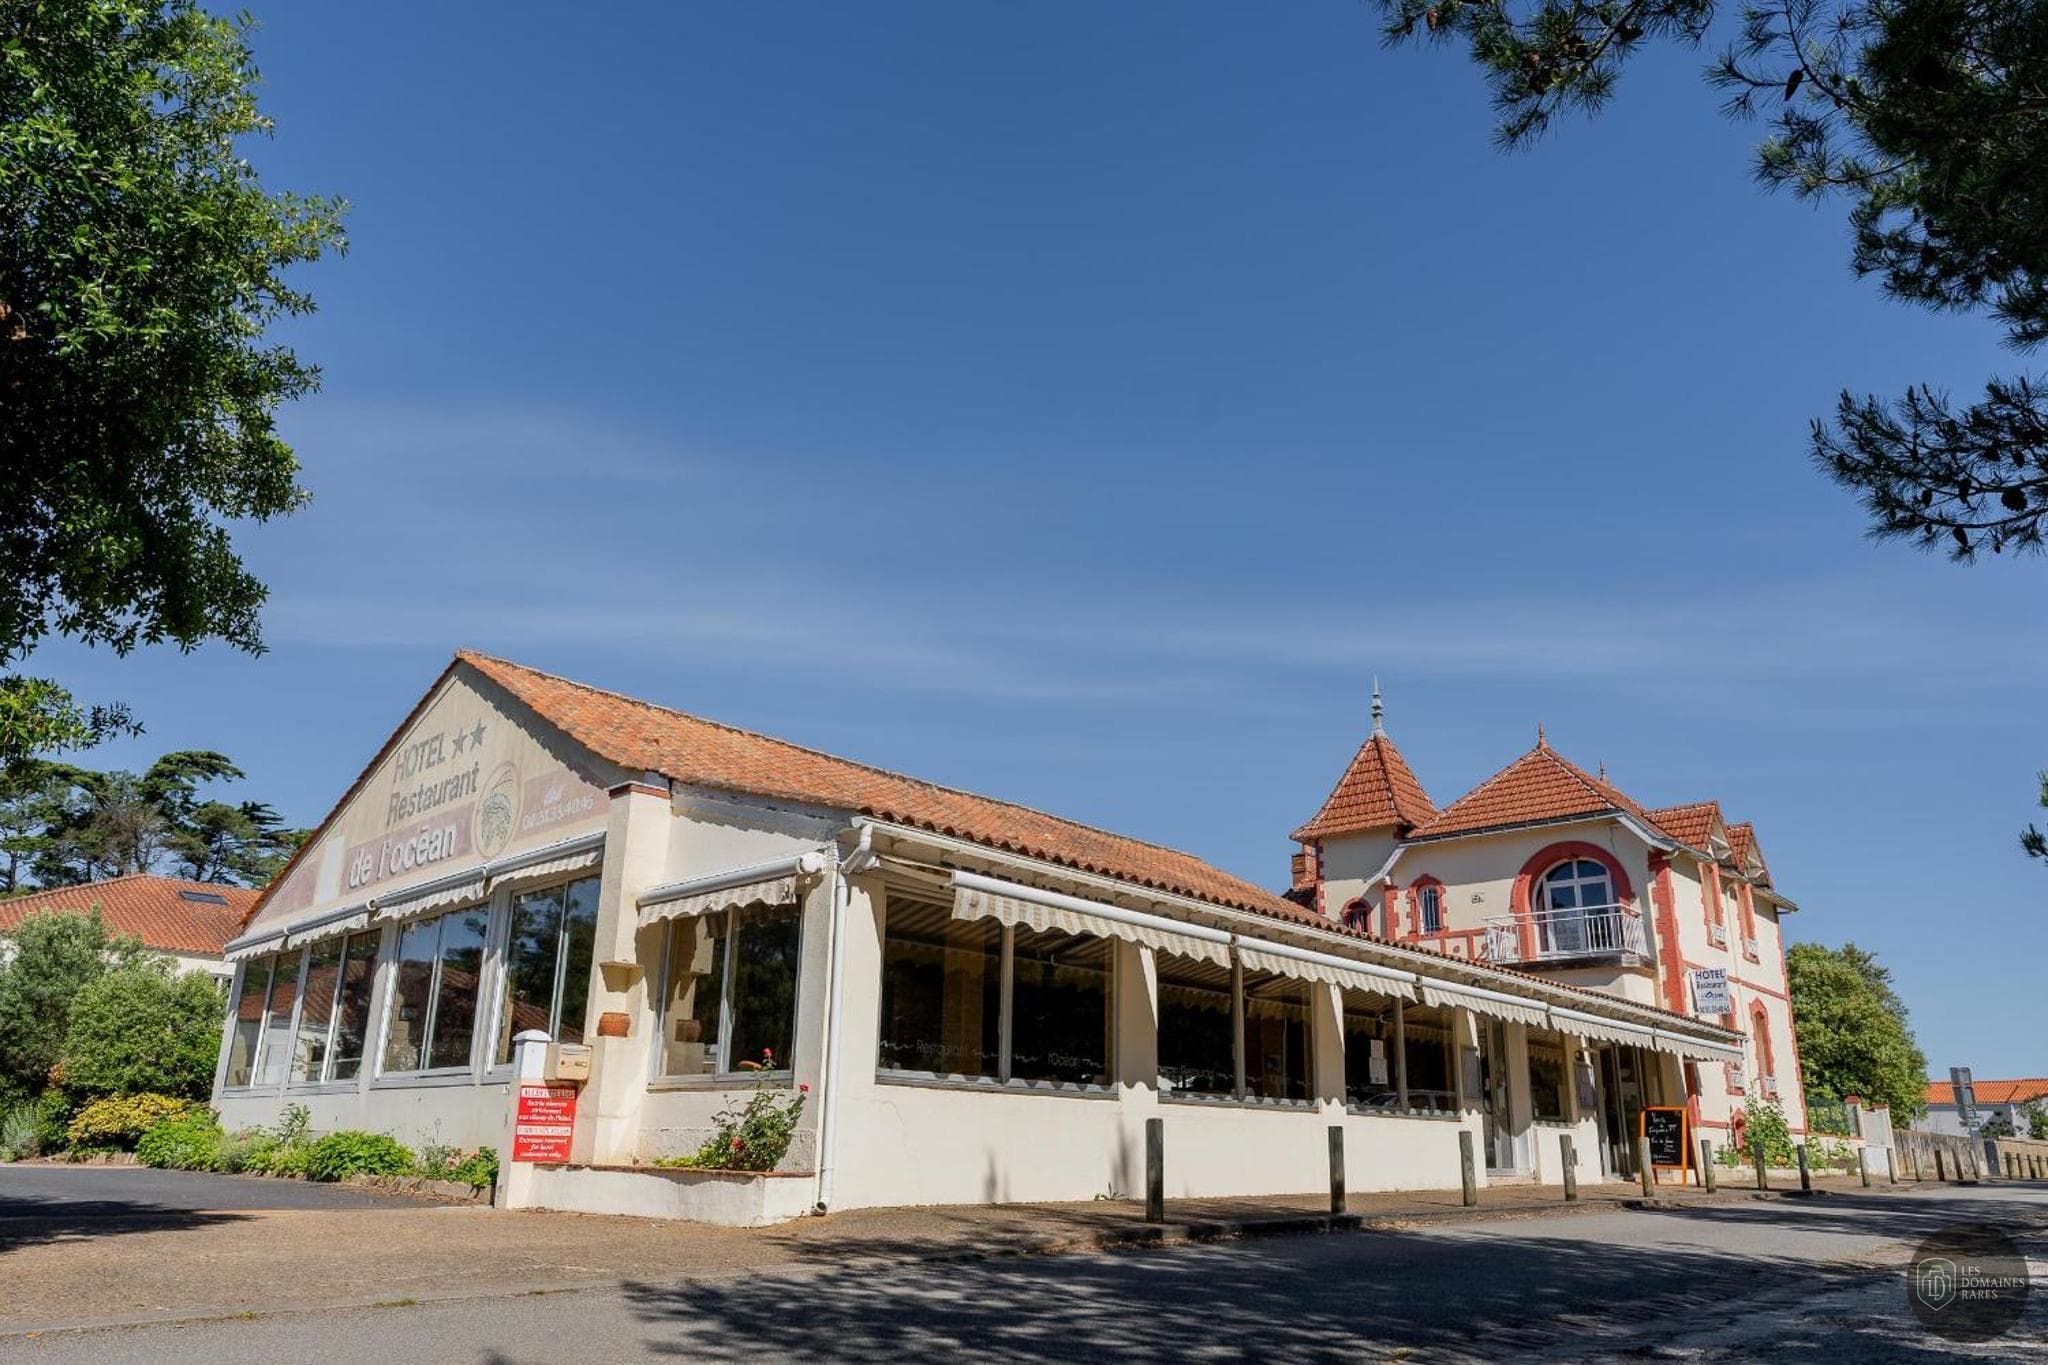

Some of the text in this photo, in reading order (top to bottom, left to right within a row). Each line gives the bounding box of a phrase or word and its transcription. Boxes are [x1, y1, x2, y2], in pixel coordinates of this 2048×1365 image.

[394, 732, 447, 783] HOTEL
[386, 761, 480, 827] Restaurant
[349, 847, 373, 888] de
[1695, 968, 1724, 980] HOTEL
